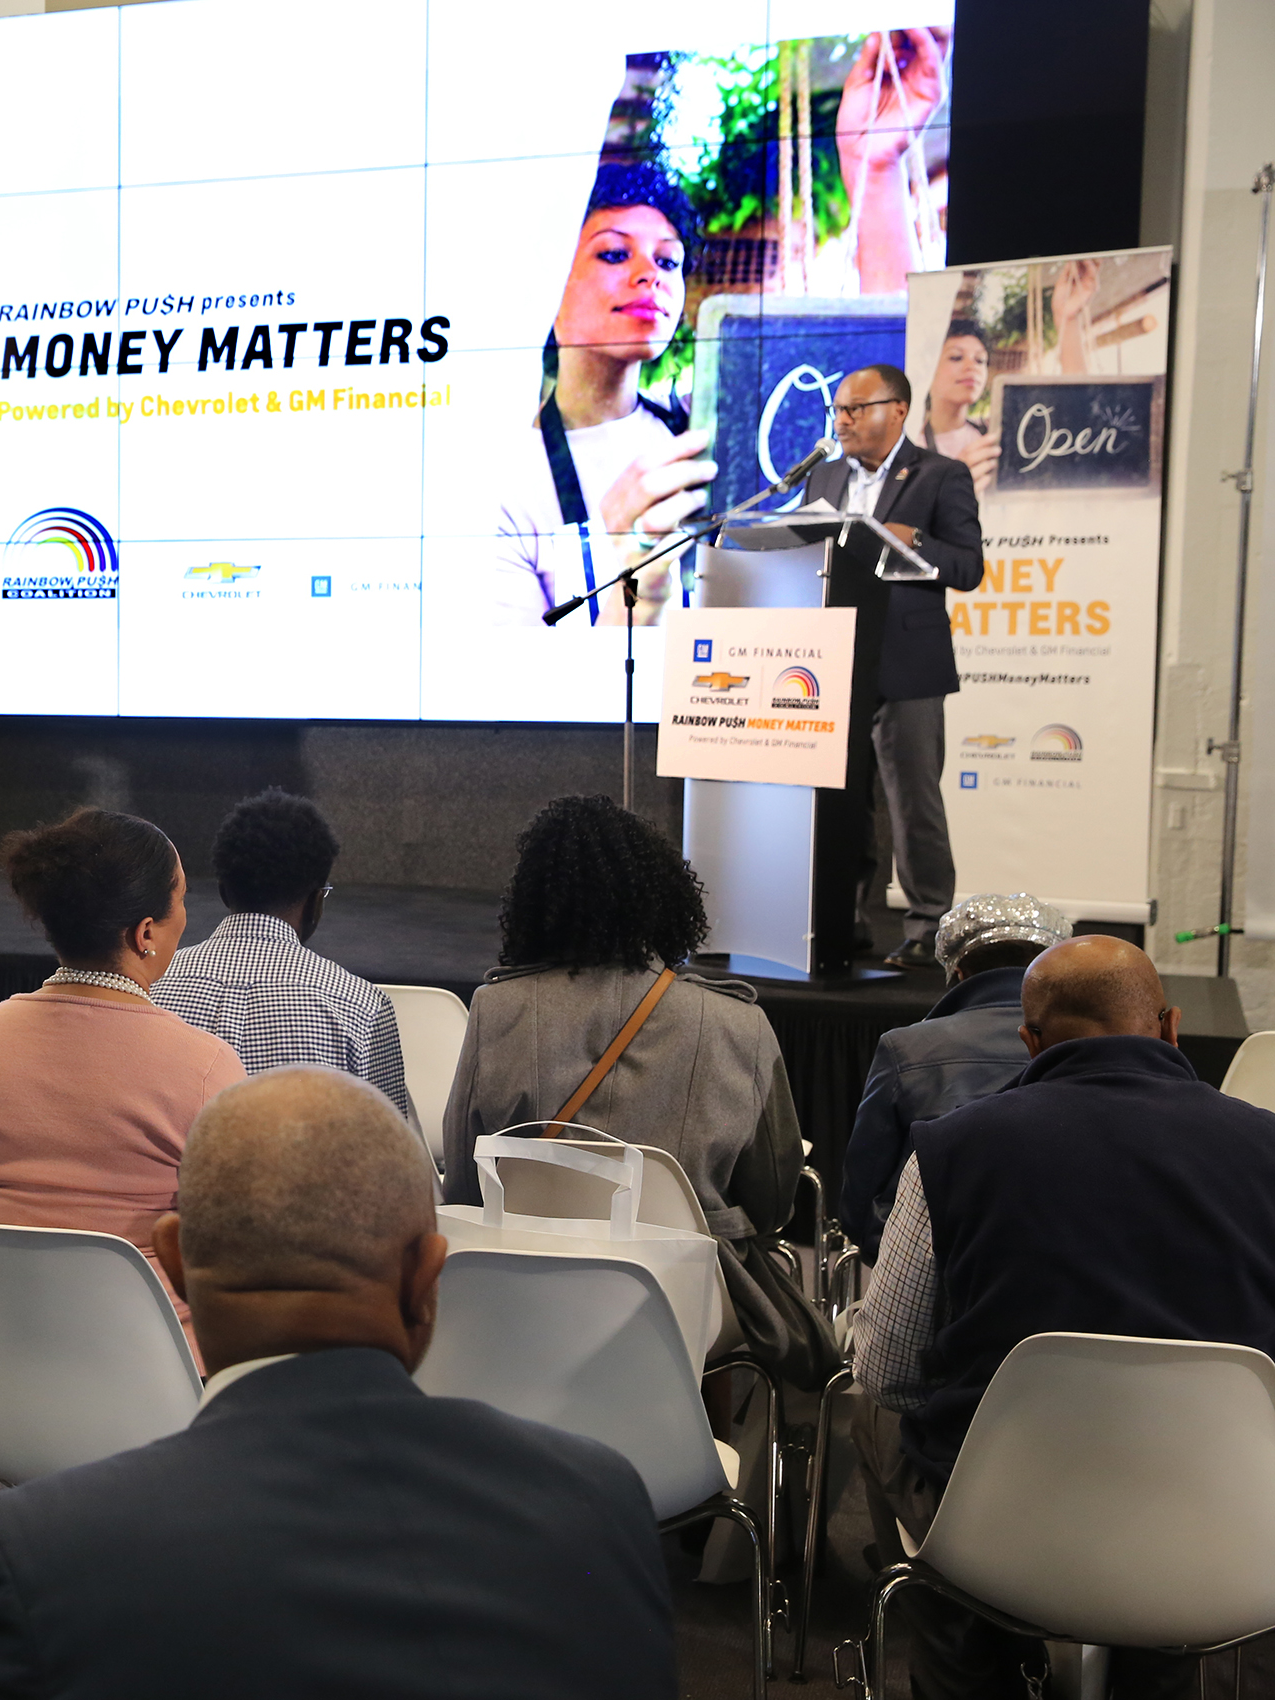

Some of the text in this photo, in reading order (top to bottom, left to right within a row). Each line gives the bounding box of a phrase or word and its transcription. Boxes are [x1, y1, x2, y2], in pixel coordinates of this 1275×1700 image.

[201, 290, 296, 315] presents
[1, 315, 451, 380] MONEY MATTERS
[107, 396, 135, 424] by
[140, 390, 260, 417] Chevrolet
[265, 390, 283, 413] &
[289, 389, 326, 412] GM
[332, 382, 452, 411] Financial
[1017, 403, 1122, 473] Open
[1048, 533, 1109, 546] Presents
[2, 576, 74, 587] RAINBOW
[952, 557, 1065, 594] NEY
[6, 589, 112, 599] COALITION
[182, 590, 261, 599] CHEVROLET
[350, 582, 371, 591] GM
[949, 599, 1112, 637] ATTERS
[728, 647, 823, 659] GM FINANCIAL
[690, 696, 749, 706] CHEVROLET
[672, 715, 718, 728] RAINBOW
[747, 718, 784, 730] MONEY
[785, 719, 835, 733] MATTERS
